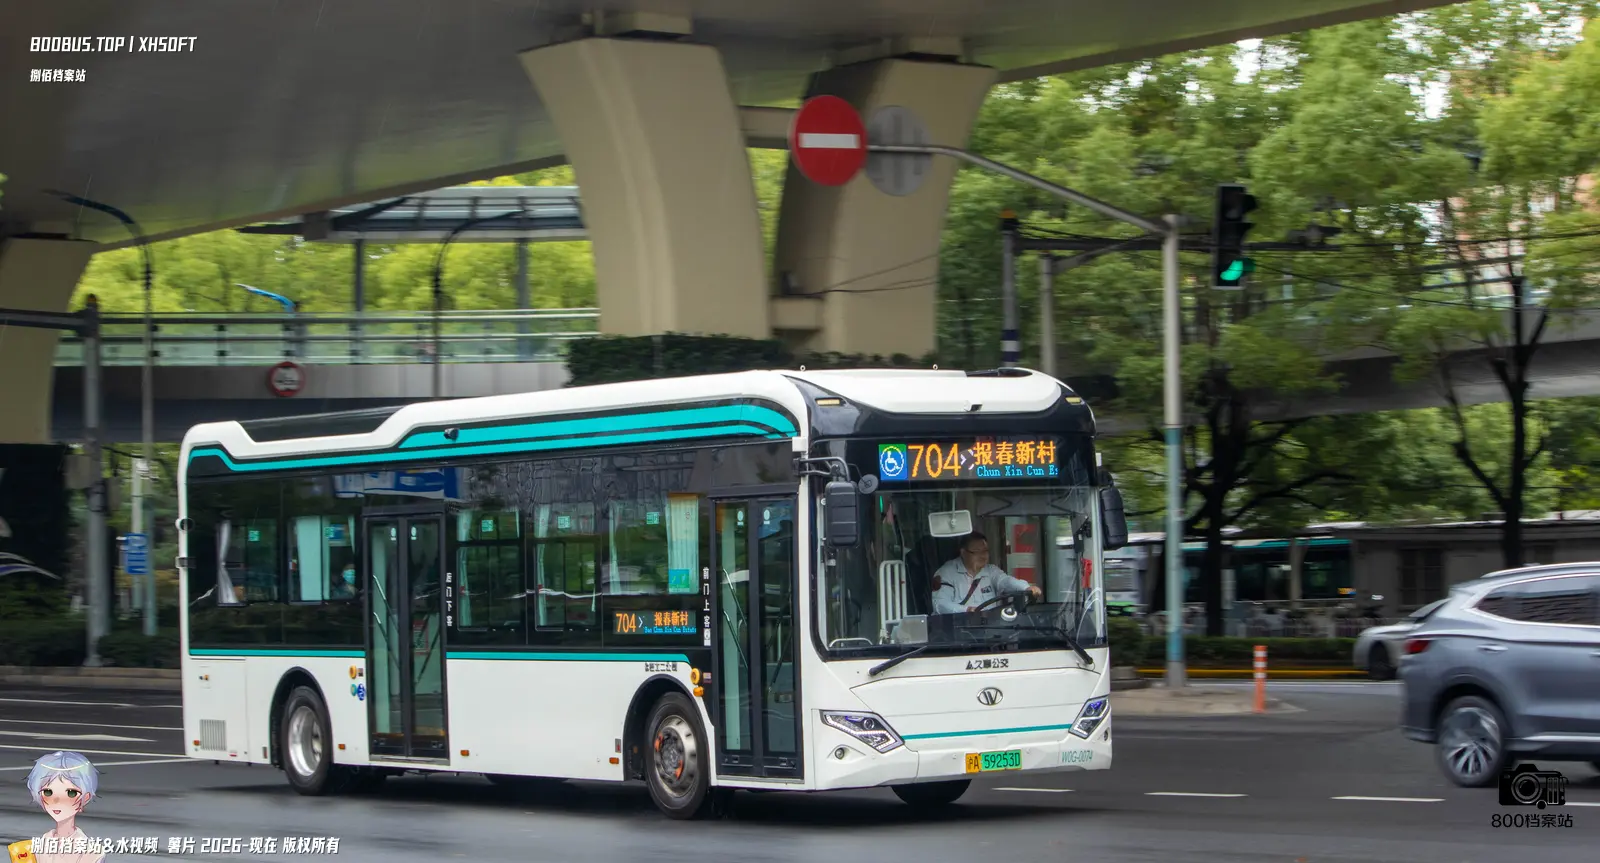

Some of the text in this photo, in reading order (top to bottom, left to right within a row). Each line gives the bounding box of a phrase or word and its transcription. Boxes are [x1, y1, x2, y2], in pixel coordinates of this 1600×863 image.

[908, 440, 1056, 478] 704 报春新村
[977, 466, 1000, 477] Chun
[1005, 465, 1022, 476] Xin
[1026, 465, 1045, 476] Cun
[616, 611, 688, 633] 704 报春新村
[984, 751, 1021, 769] 59253D
